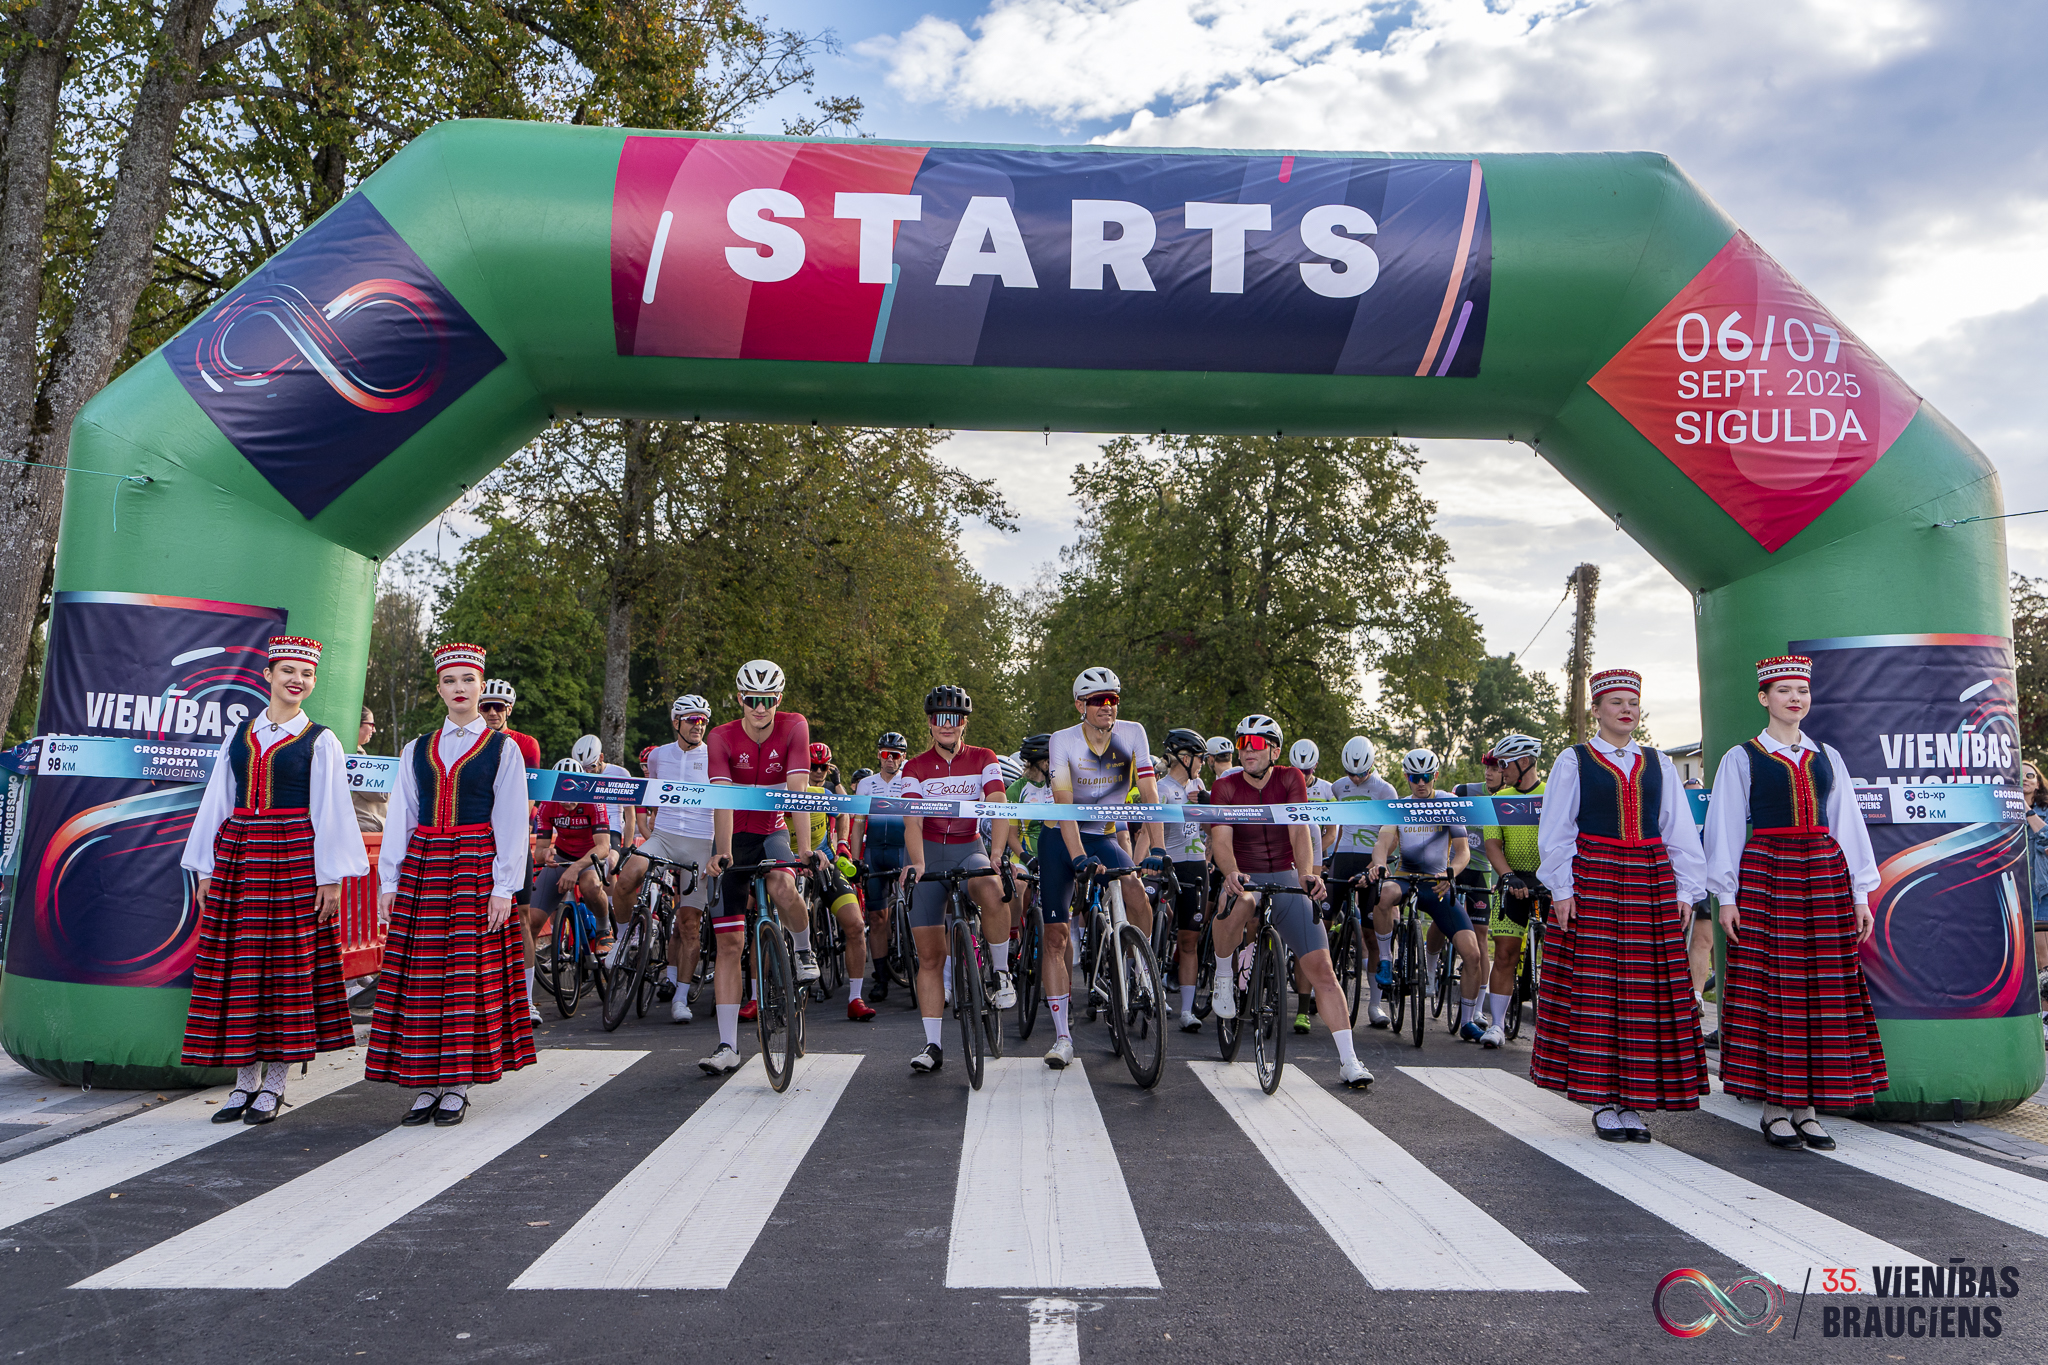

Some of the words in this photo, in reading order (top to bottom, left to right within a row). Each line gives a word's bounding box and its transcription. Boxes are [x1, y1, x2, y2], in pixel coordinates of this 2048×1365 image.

[724, 188, 1379, 298] STARTS
[1676, 310, 1841, 364] 06/07
[1677, 369, 1774, 399] SEPT.
[1786, 369, 1861, 398] 2025
[1674, 408, 1867, 445] SIGULDA
[57, 743, 79, 753] cb-xp
[1879, 725, 2012, 769] VIENĪBAS
[47, 757, 61, 771] 98
[62, 762, 76, 771] KM
[152, 757, 199, 768] SPORTA
[359, 761, 390, 772] cb-xp
[142, 767, 206, 779] BRAUCIENS
[365, 779, 385, 788] KM
[675, 785, 705, 794] cb-xp
[658, 794, 681, 805] 98
[682, 798, 702, 806] KM
[765, 791, 852, 802] CROSSBORDER
[1917, 790, 1946, 801] cb-xp
[774, 804, 838, 812] BRAUCIENS
[1299, 805, 1329, 813] cb-xp
[1387, 800, 1474, 809] CROSSBORDER
[974, 809, 996, 817] 98
[1287, 813, 1311, 822] 98
[1905, 805, 1927, 819] 98
[1929, 809, 1947, 818] KM
[1403, 815, 1467, 823] BRAUCIENS
